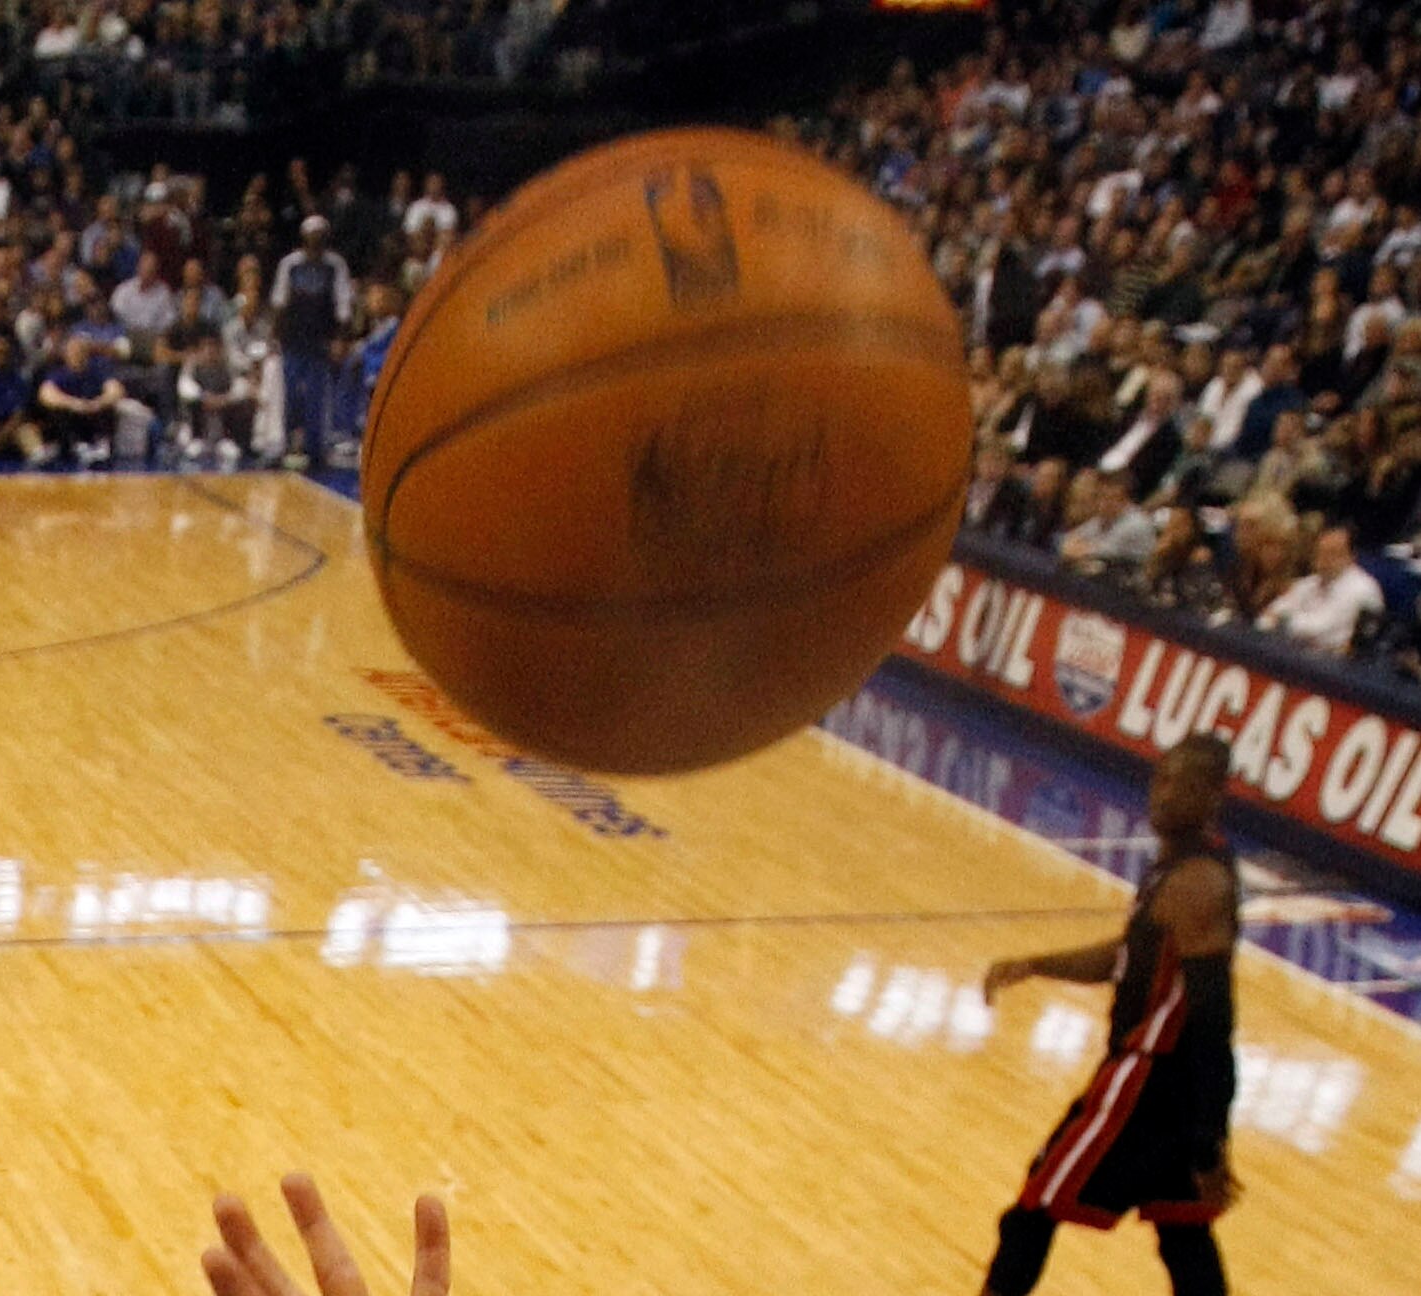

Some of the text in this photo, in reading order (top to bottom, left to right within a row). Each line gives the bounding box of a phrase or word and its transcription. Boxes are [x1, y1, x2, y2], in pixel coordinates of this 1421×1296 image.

[957, 578, 1043, 689] OIL
[1117, 637, 1331, 801] LUCAS
[1318, 713, 1421, 851] OIL
